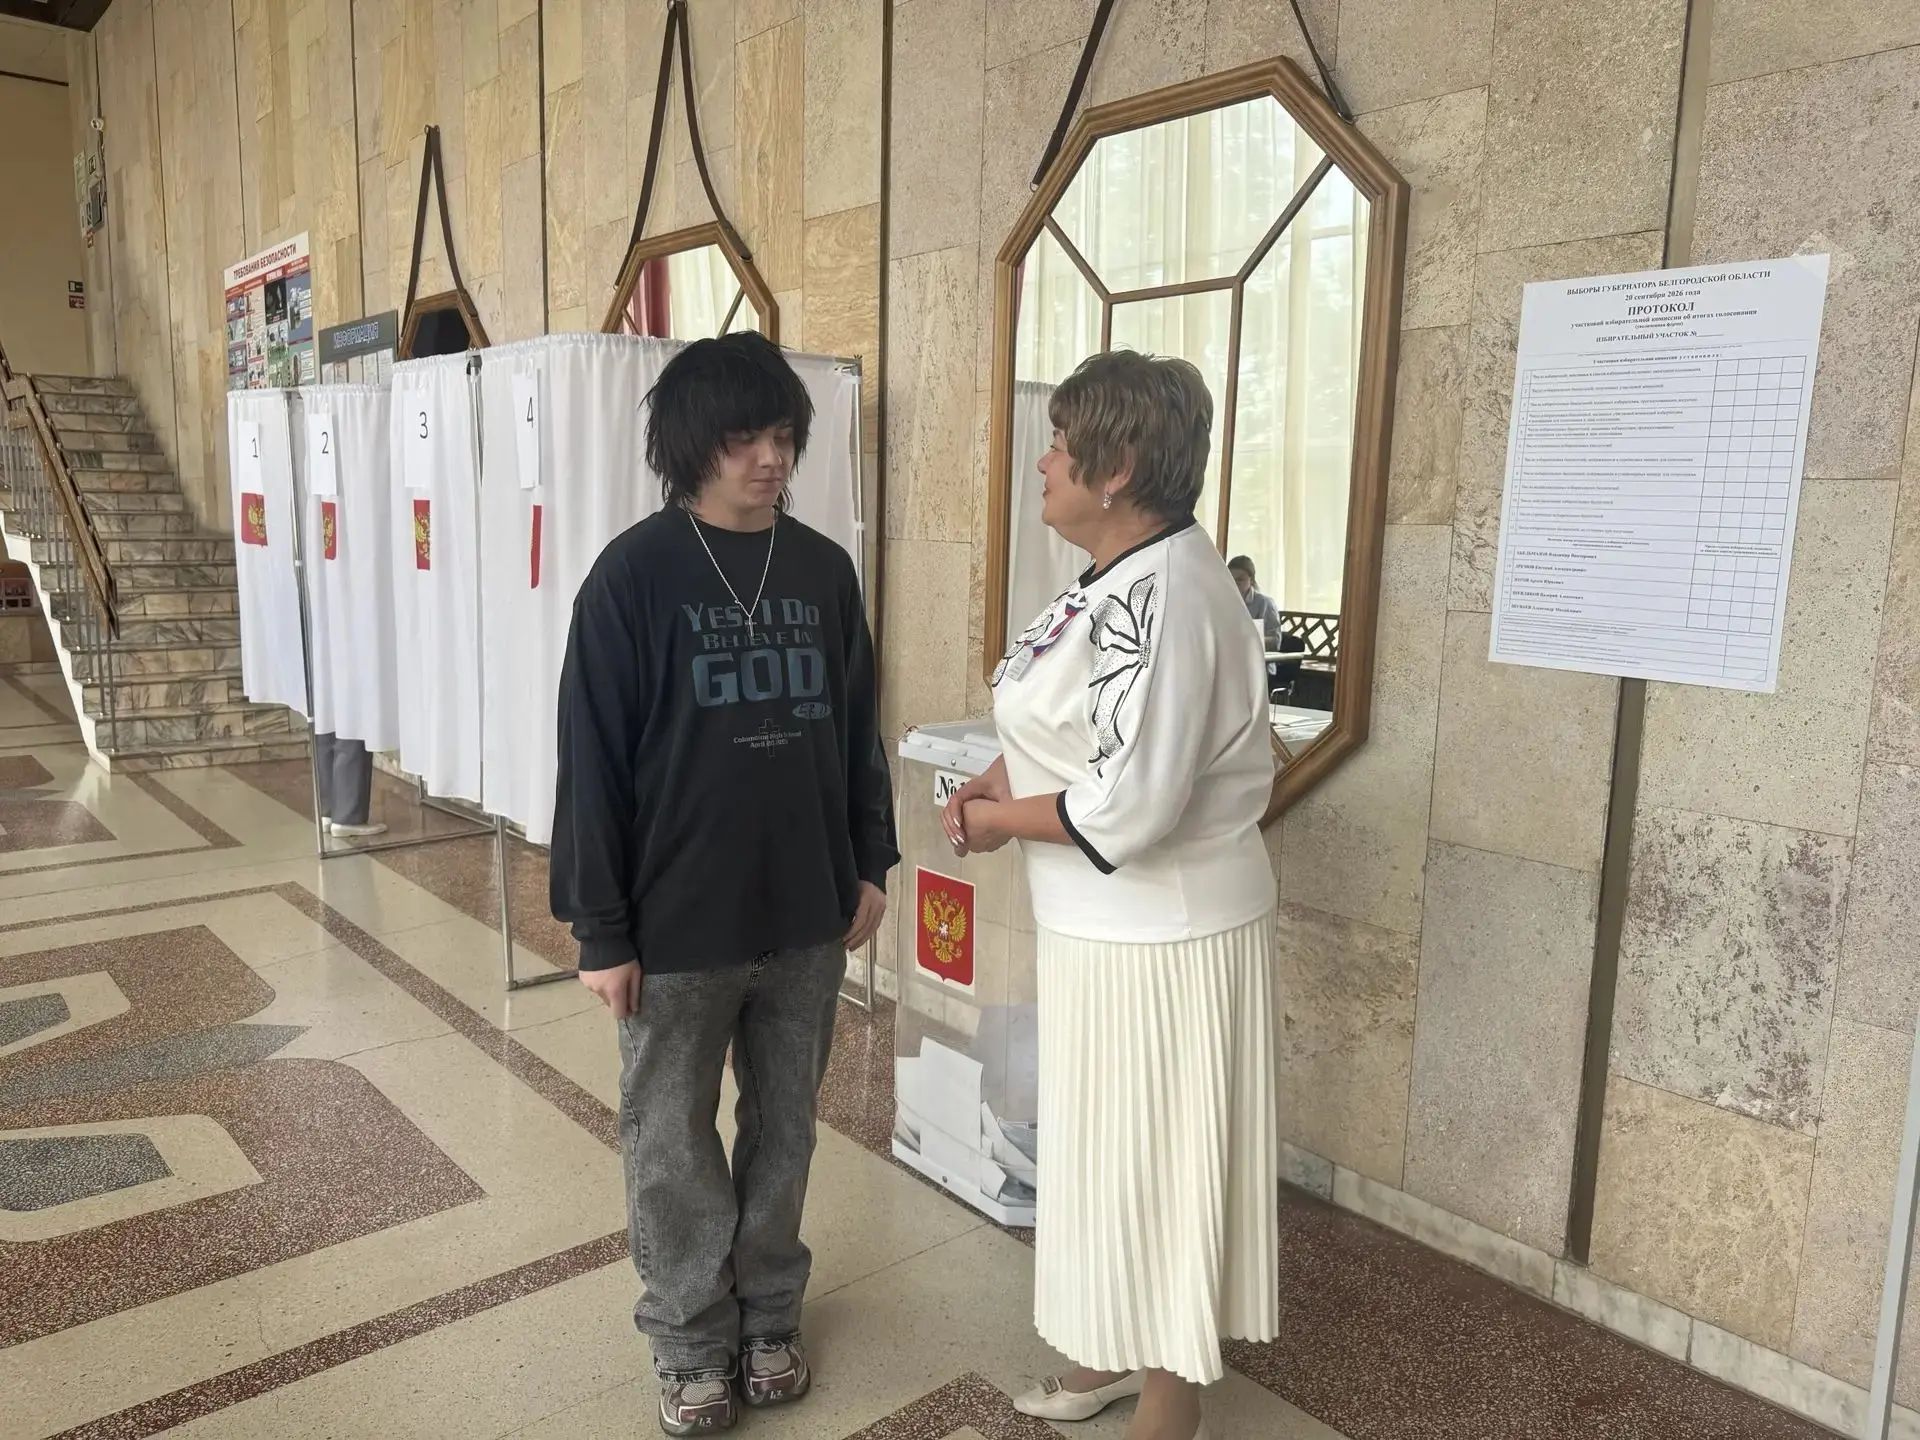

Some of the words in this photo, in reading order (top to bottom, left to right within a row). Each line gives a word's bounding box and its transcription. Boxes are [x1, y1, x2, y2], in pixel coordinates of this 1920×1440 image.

[260, 243, 297, 269] БЕЗОПАСНОСТИ
[1567, 286, 1601, 296] ВЫБОРЫ
[1602, 281, 1657, 292] ГУБЕРНАТОРА
[1659, 274, 1726, 287] БЕЛГОРОДСКОЙ
[1728, 270, 1771, 281] ОБЛАСТИ
[1625, 294, 1633, 302] 20
[1634, 291, 1666, 302] сентября
[1667, 289, 1684, 298] 2026
[1685, 288, 1701, 297] года
[1604, 317, 1650, 327] избирательной
[1651, 314, 1682, 323] комиссии
[1692, 312, 1714, 320] итогах
[1715, 308, 1758, 318] голосования
[1627, 301, 1695, 316] ПРОТОКОЛ
[1596, 332, 1654, 343] ИЗБИРАТЕЛЬНЫЙ
[1655, 330, 1690, 340] УЧАСТОК
[526, 397, 534, 428] 4
[419, 411, 429, 439] 3
[251, 437, 259, 458] 1
[321, 431, 329, 454] 2
[761, 599, 773, 625] I
[692, 648, 825, 708] GOD
